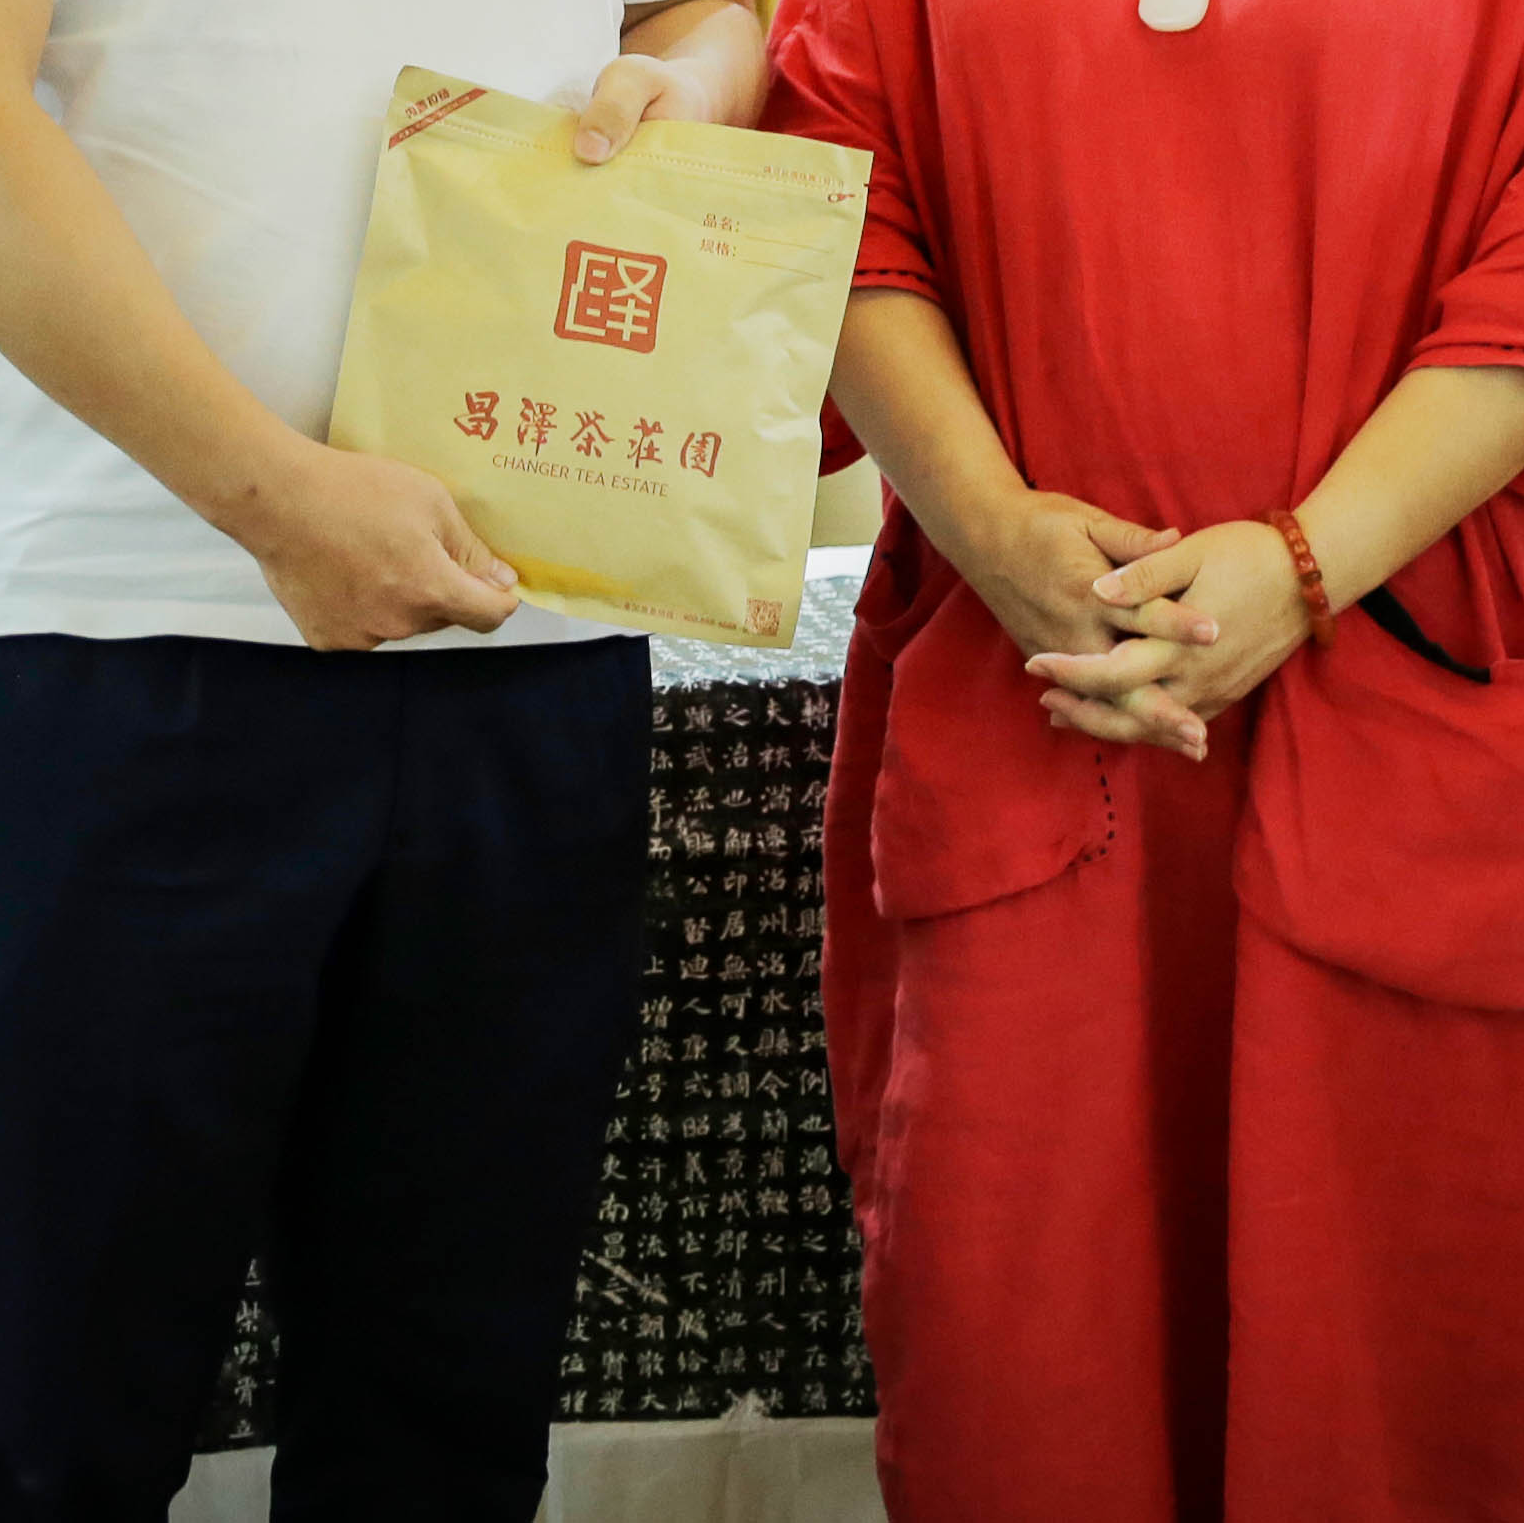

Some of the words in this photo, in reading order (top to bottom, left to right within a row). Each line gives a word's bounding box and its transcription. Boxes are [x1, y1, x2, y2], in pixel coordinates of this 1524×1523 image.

[492, 454, 570, 480] CHANGER
[577, 468, 606, 489] TEA
[611, 475, 670, 498] ESTATE
